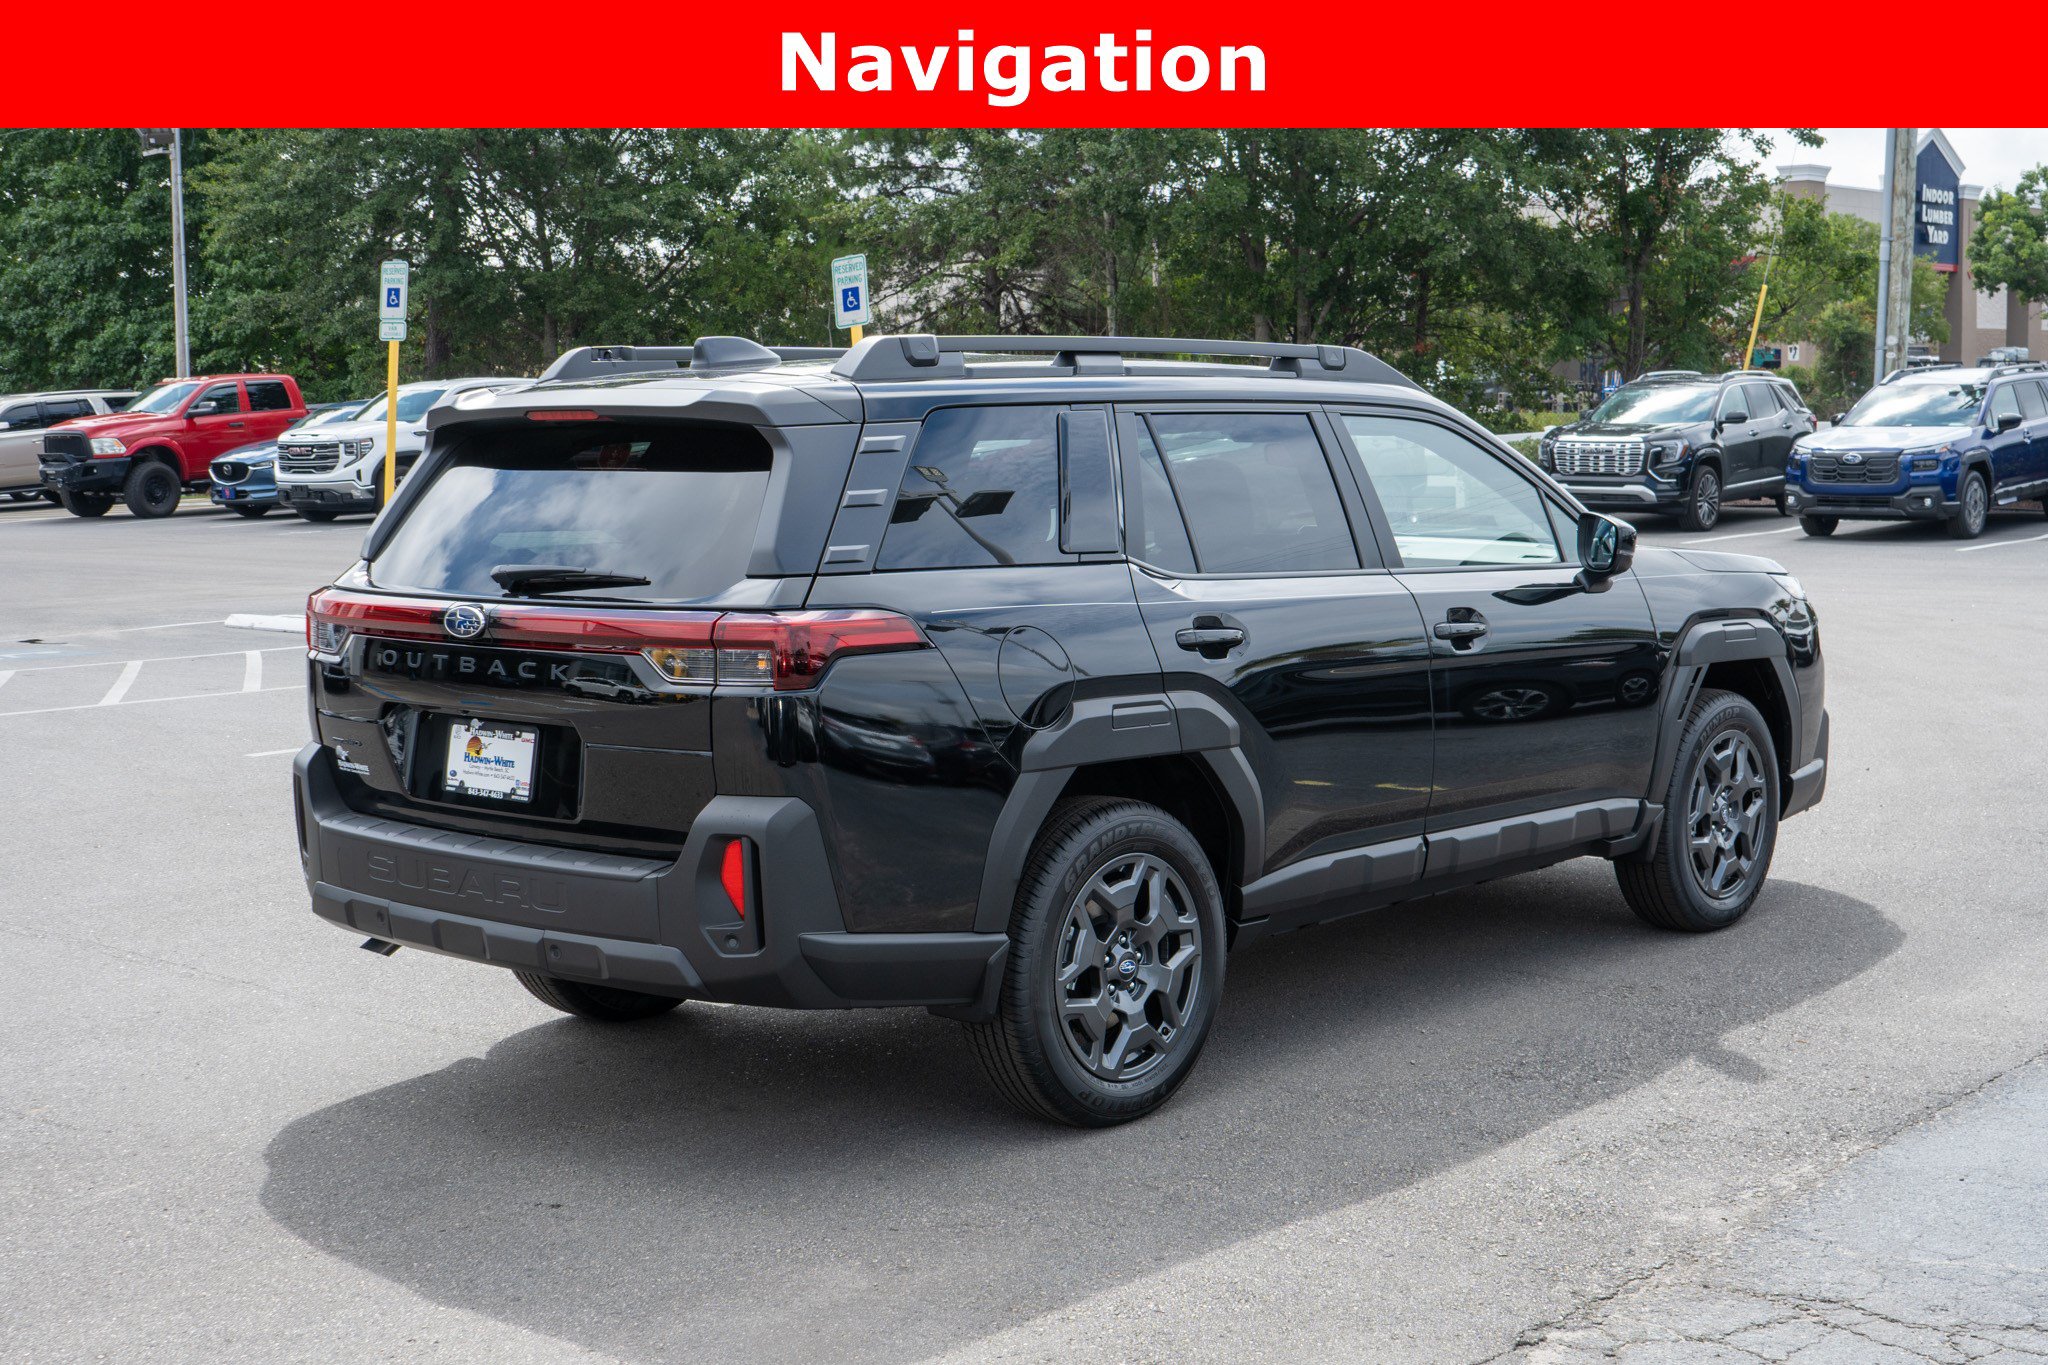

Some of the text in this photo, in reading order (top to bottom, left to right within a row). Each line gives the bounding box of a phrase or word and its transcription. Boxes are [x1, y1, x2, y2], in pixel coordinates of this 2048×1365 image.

[1922, 184, 1954, 205] INDOOR
[1922, 204, 1953, 225] LUMBER
[1927, 225, 1949, 244] YARD
[835, 262, 863, 274] RESERVED
[384, 277, 404, 285] PARKING
[837, 274, 862, 286] PARKING
[288, 447, 311, 455] GMC
[382, 650, 569, 681] OUTBACK
[464, 751, 515, 768] HADWIN-WHITE
[468, 787, 503, 799] 843-347-4633
[367, 850, 568, 914] SUBARU
